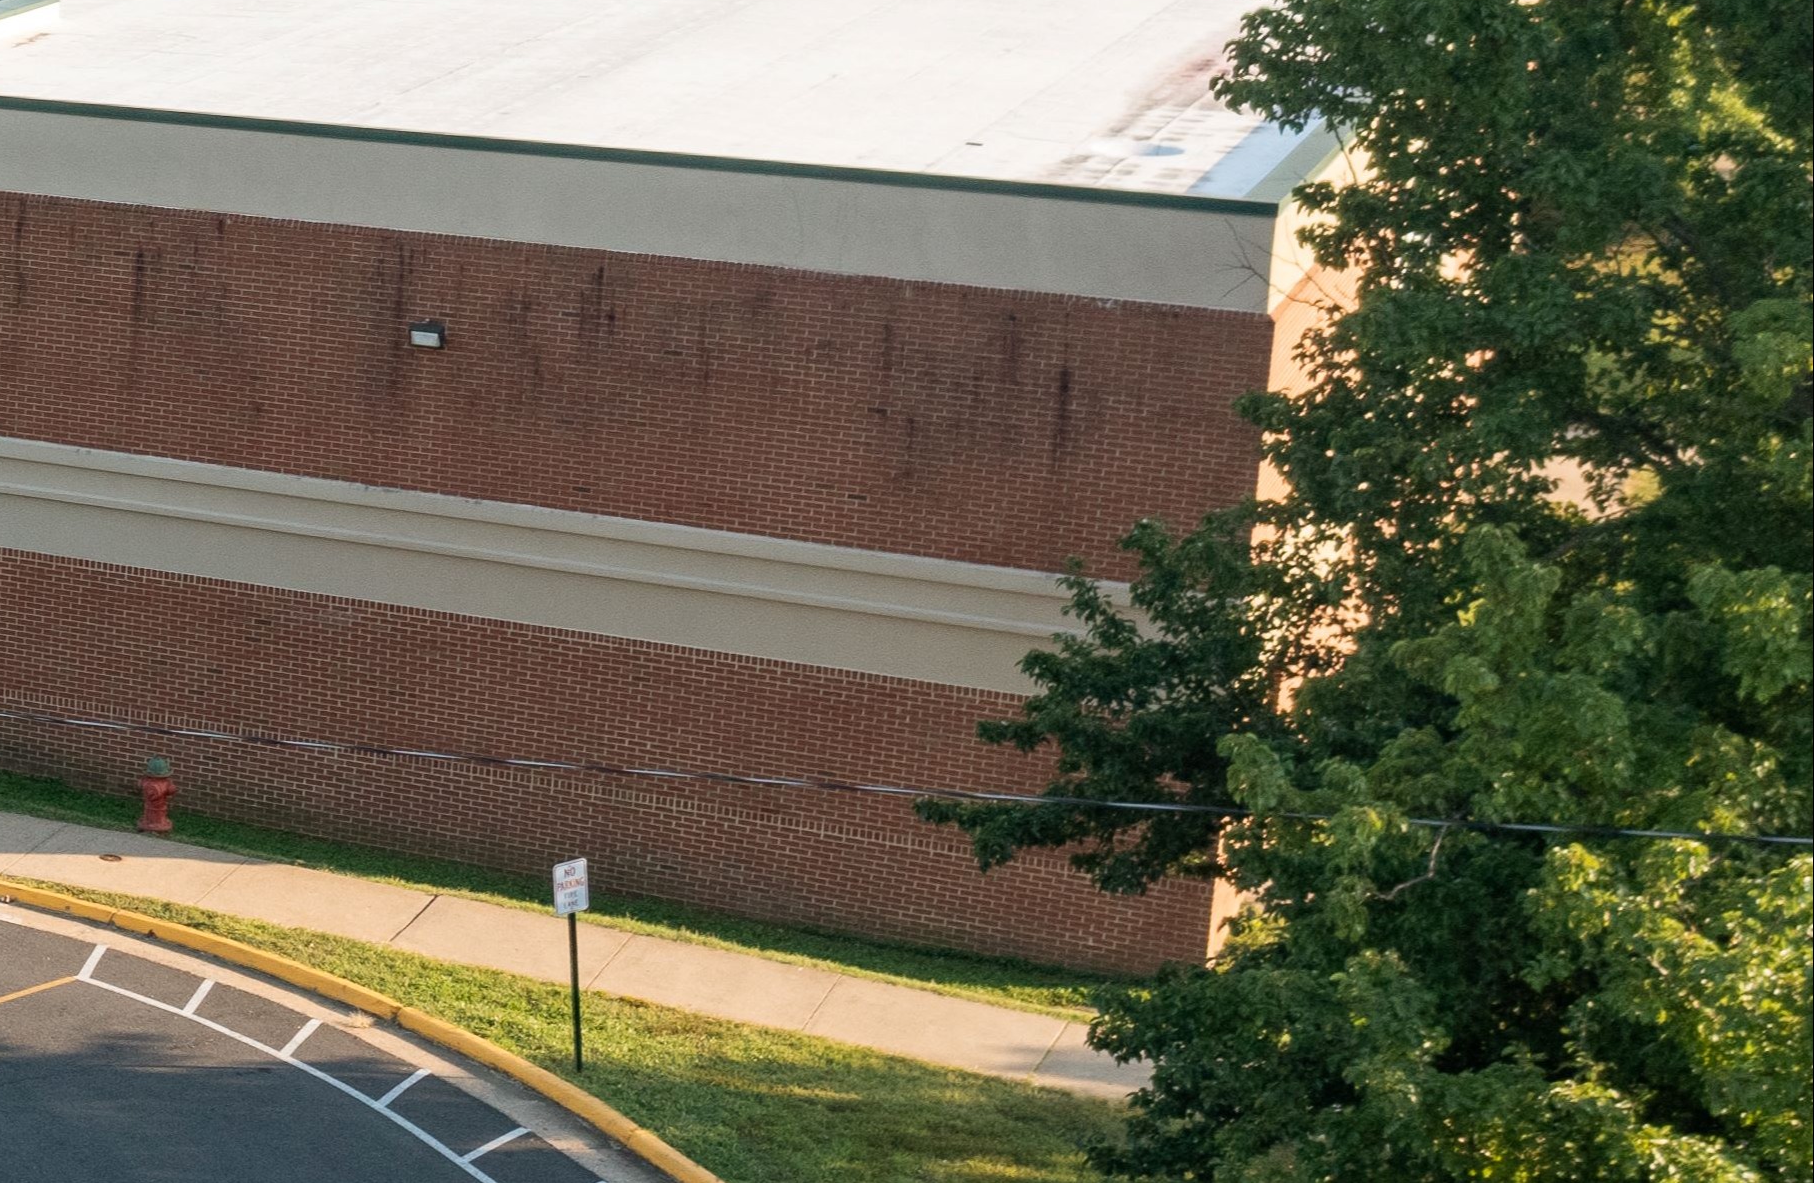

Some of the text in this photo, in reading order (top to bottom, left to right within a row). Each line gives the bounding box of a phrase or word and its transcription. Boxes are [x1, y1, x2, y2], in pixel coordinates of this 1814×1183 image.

[564, 866, 576, 878] NO
[557, 877, 585, 892] PARKING
[563, 899, 579, 909] LANE
